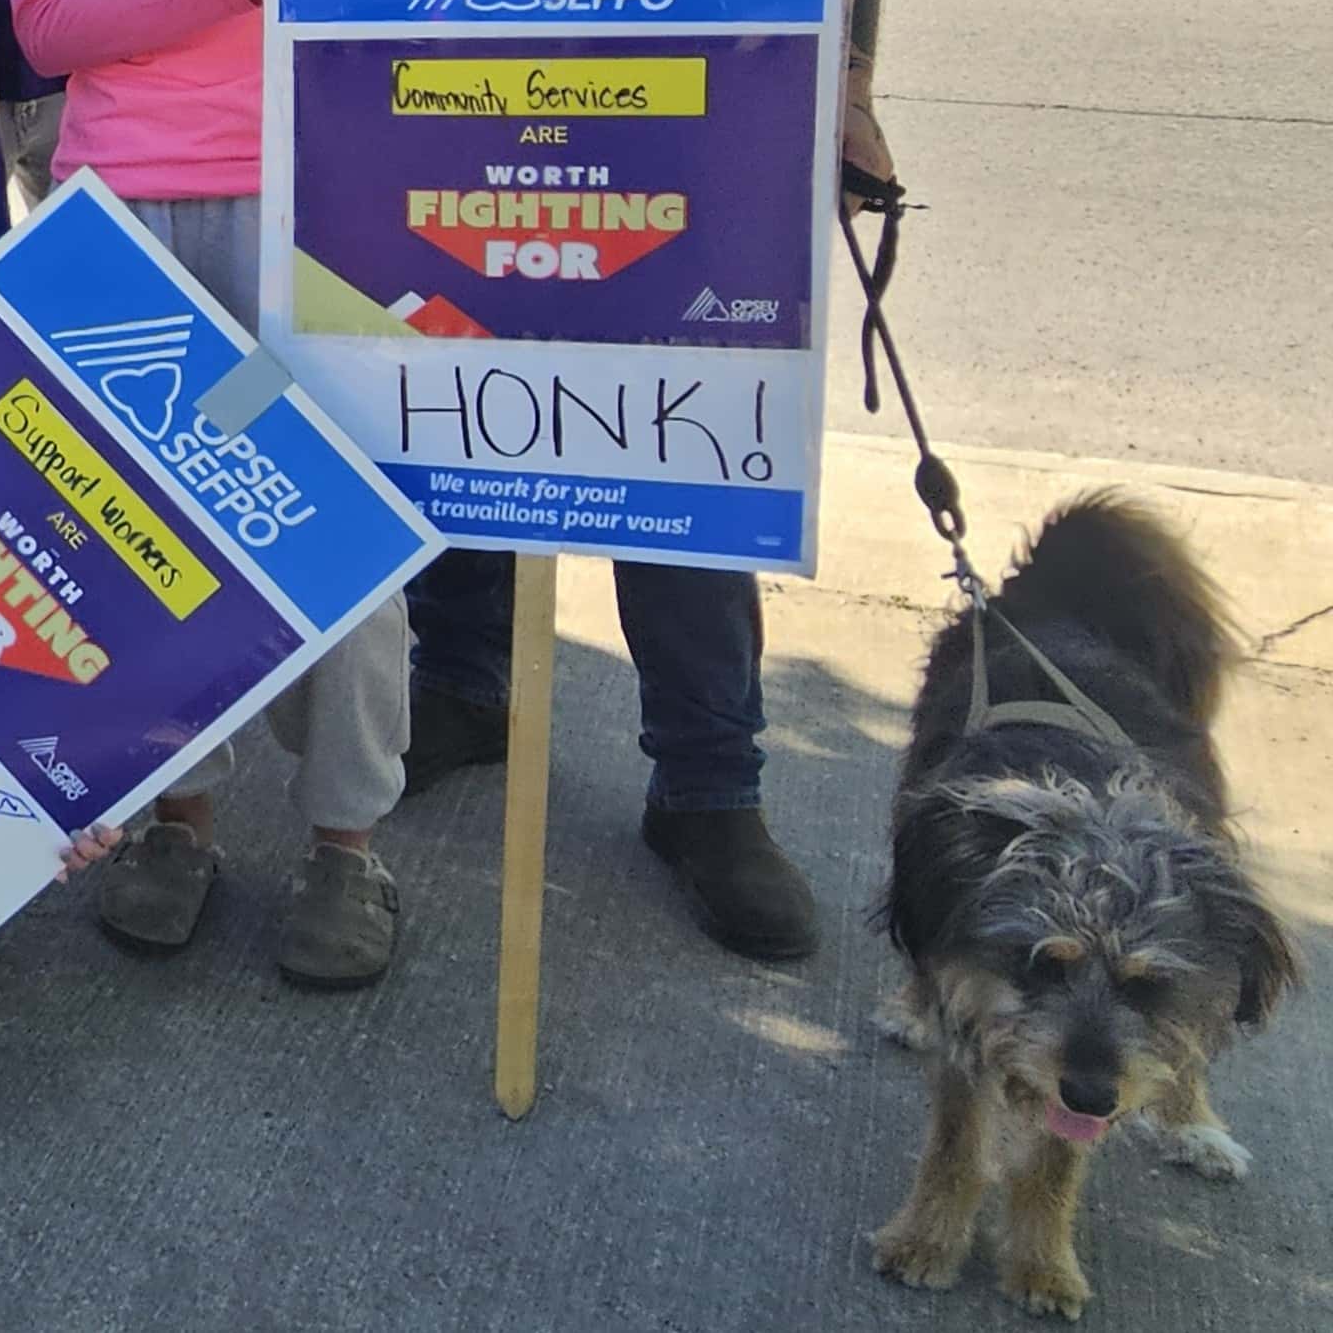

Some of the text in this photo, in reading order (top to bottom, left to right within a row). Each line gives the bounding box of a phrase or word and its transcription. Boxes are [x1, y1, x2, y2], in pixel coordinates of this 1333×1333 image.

[393, 60, 648, 115] Community Services
[519, 126, 568, 144] ARE
[485, 165, 610, 187] WORTH
[407, 190, 688, 232] FIGHTING
[484, 240, 603, 281] FOR
[729, 310, 777, 323] SEFPO
[731, 299, 779, 312] OPSEU
[399, 364, 773, 481] HONK!
[2, 393, 101, 498] Support
[159, 431, 280, 548] SEFPO
[430, 472, 627, 506] We work for you!
[46, 511, 89, 550] ARE
[431, 500, 558, 526] travaillons
[562, 509, 622, 531] pour
[626, 514, 693, 536] vous!
